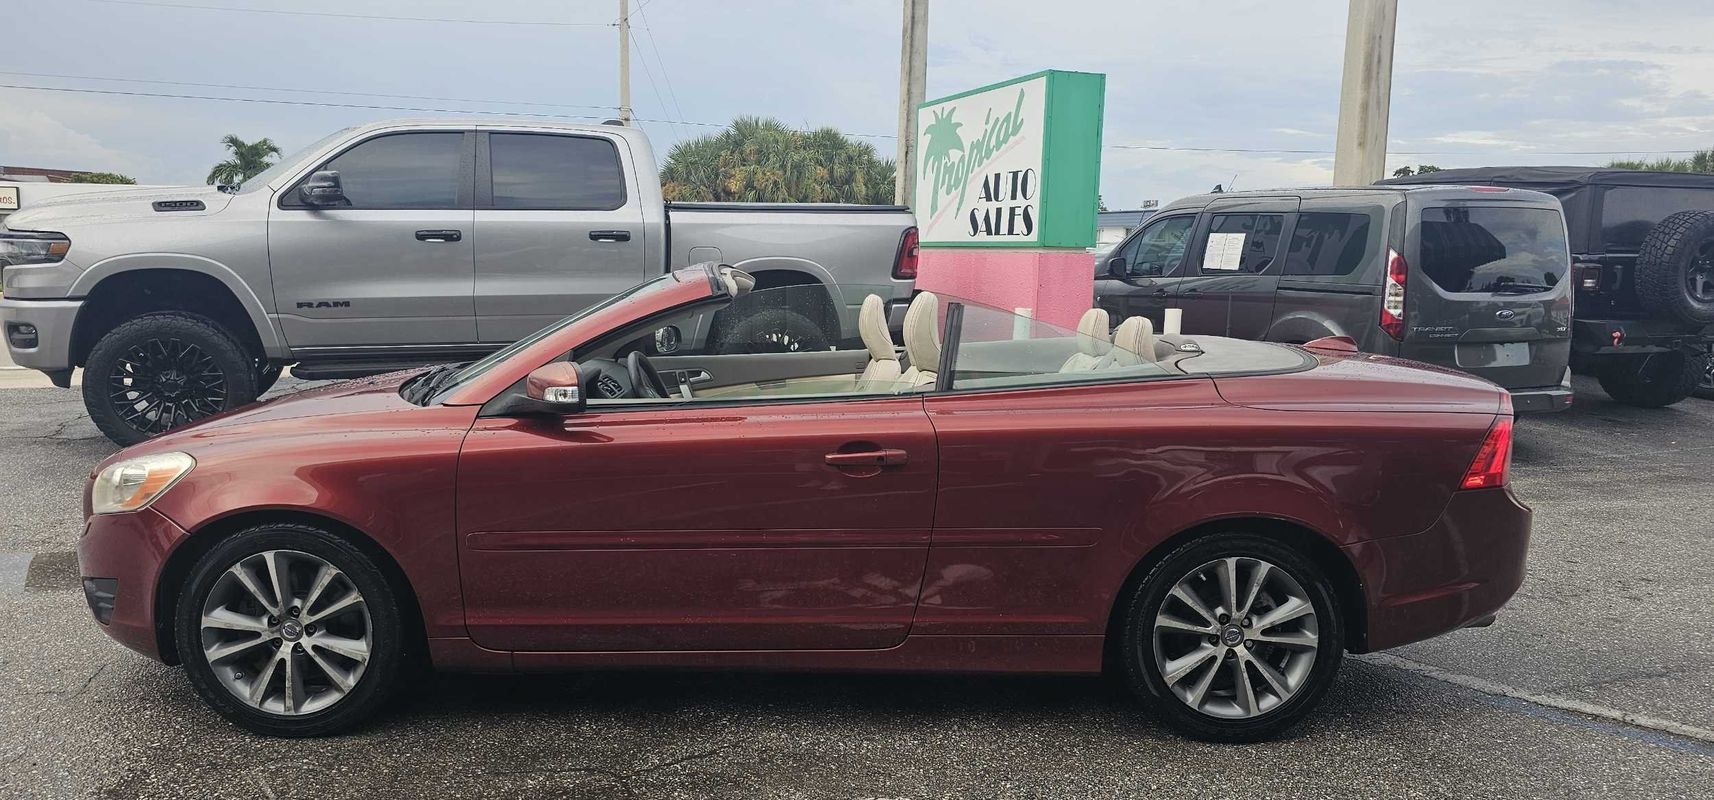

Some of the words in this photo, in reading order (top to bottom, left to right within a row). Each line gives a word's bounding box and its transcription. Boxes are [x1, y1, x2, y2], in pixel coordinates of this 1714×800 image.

[926, 88, 1025, 220] Tropical
[977, 168, 1037, 203] AUTO
[968, 205, 1034, 237] SALES
[296, 301, 351, 309] RAM
